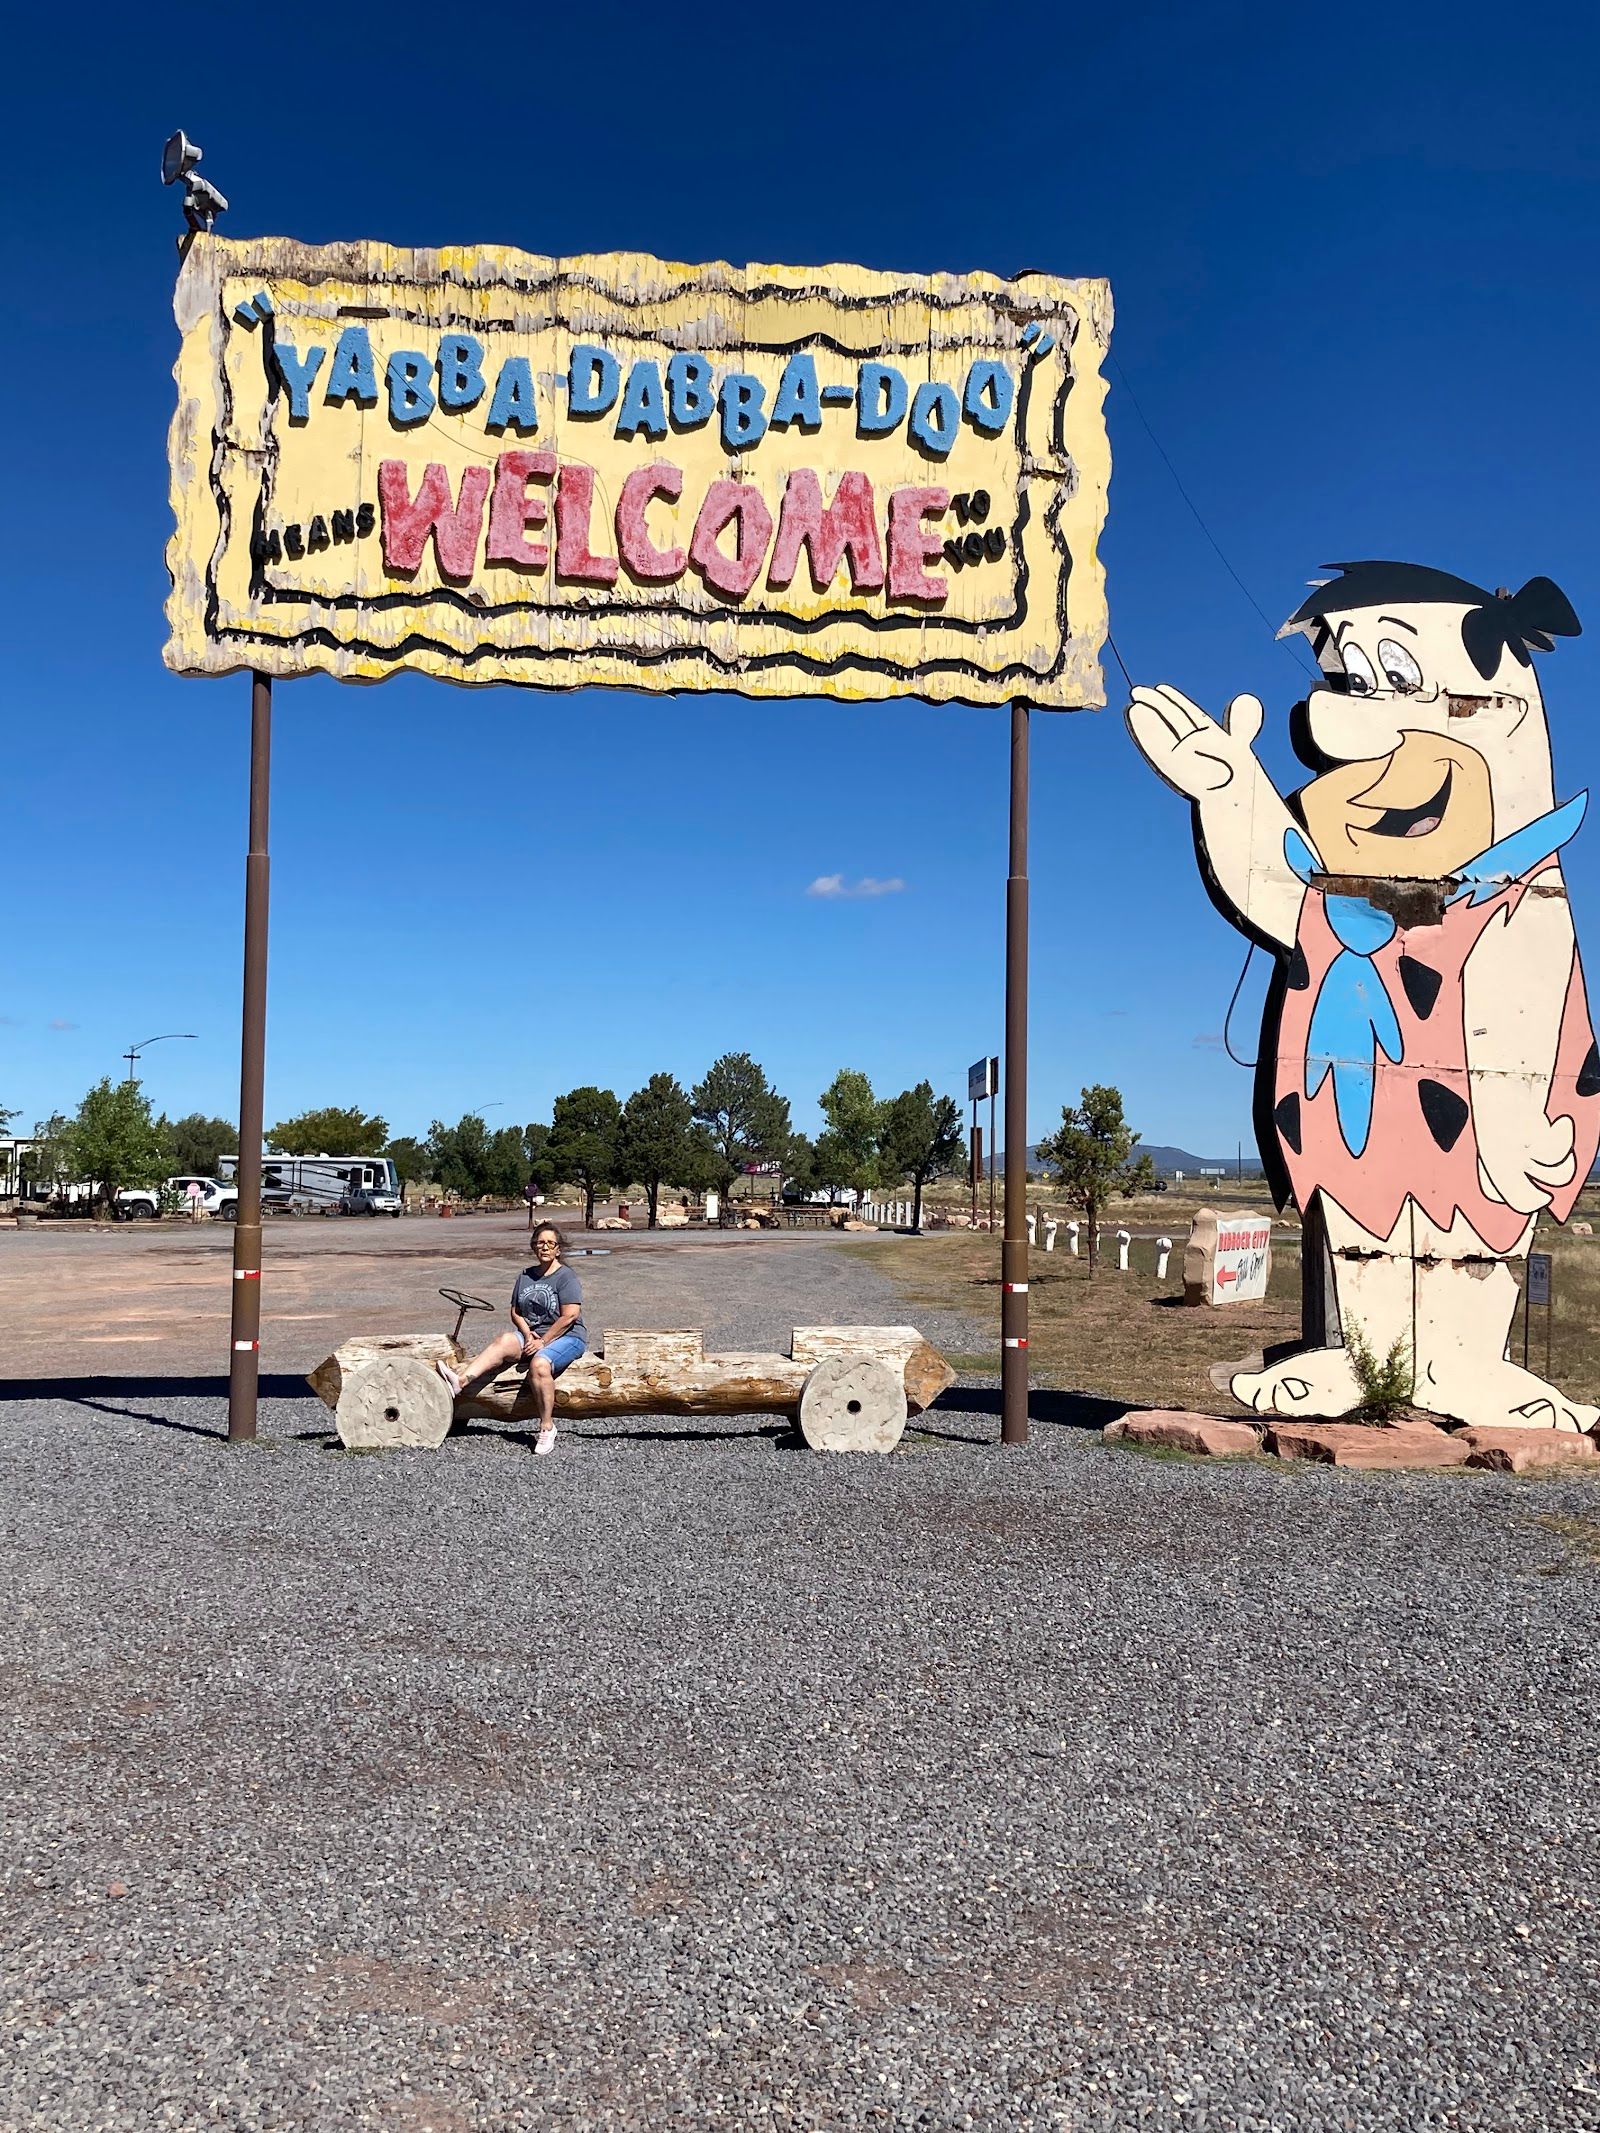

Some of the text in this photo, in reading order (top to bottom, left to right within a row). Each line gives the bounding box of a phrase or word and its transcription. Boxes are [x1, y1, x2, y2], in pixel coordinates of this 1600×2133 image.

[255, 450, 950, 602] MEANS WELCOME
[950, 490, 990, 527] TO
[943, 527, 1006, 573] YOU
[1253, 1230, 1269, 1249] CITY
